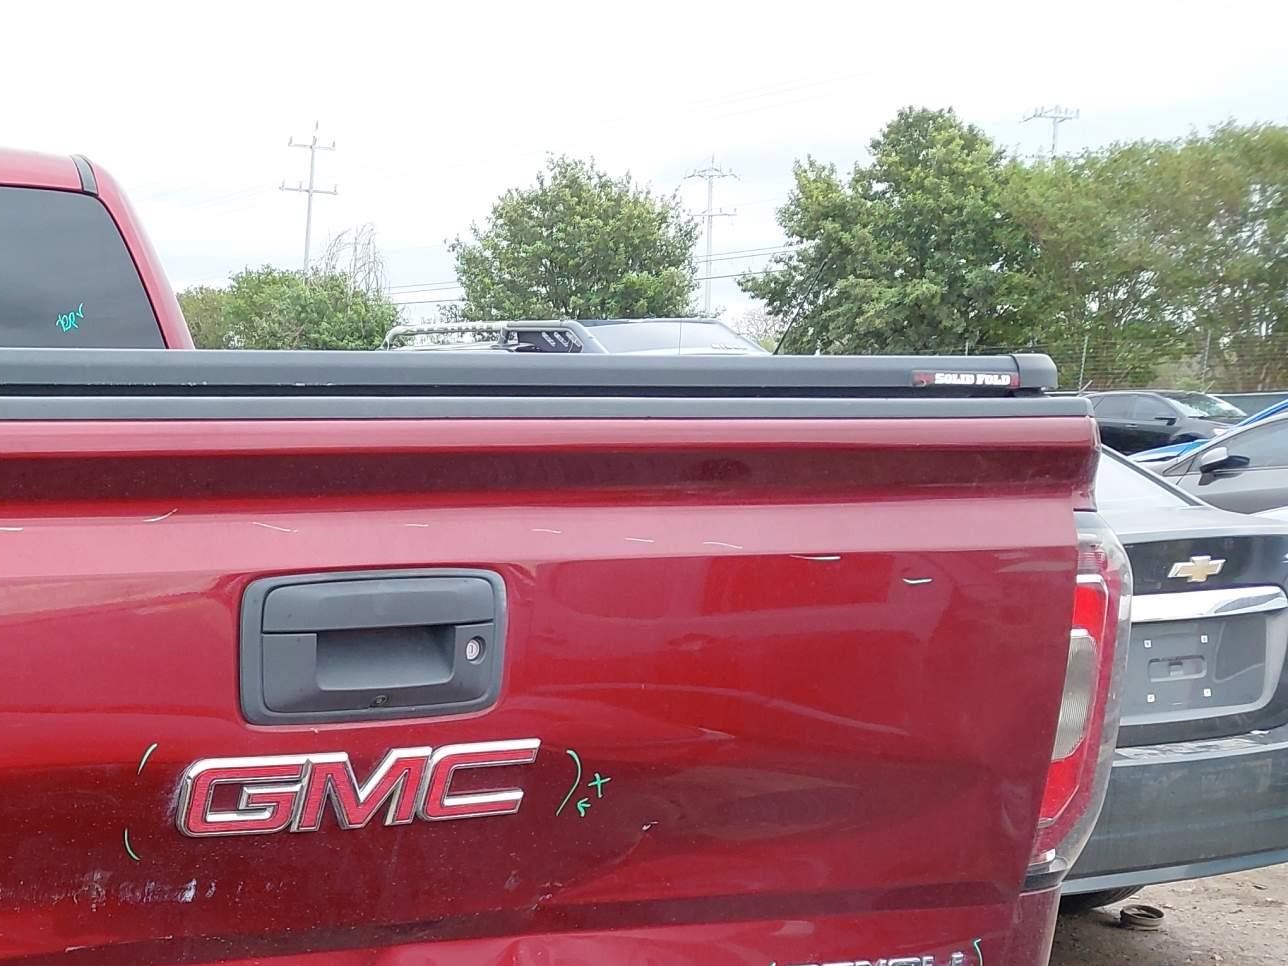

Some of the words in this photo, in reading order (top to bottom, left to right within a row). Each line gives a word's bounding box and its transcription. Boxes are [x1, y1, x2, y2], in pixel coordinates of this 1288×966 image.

[934, 372, 975, 385] SOLID
[975, 374, 1011, 386] FOLD
[175, 738, 542, 838] GMC
